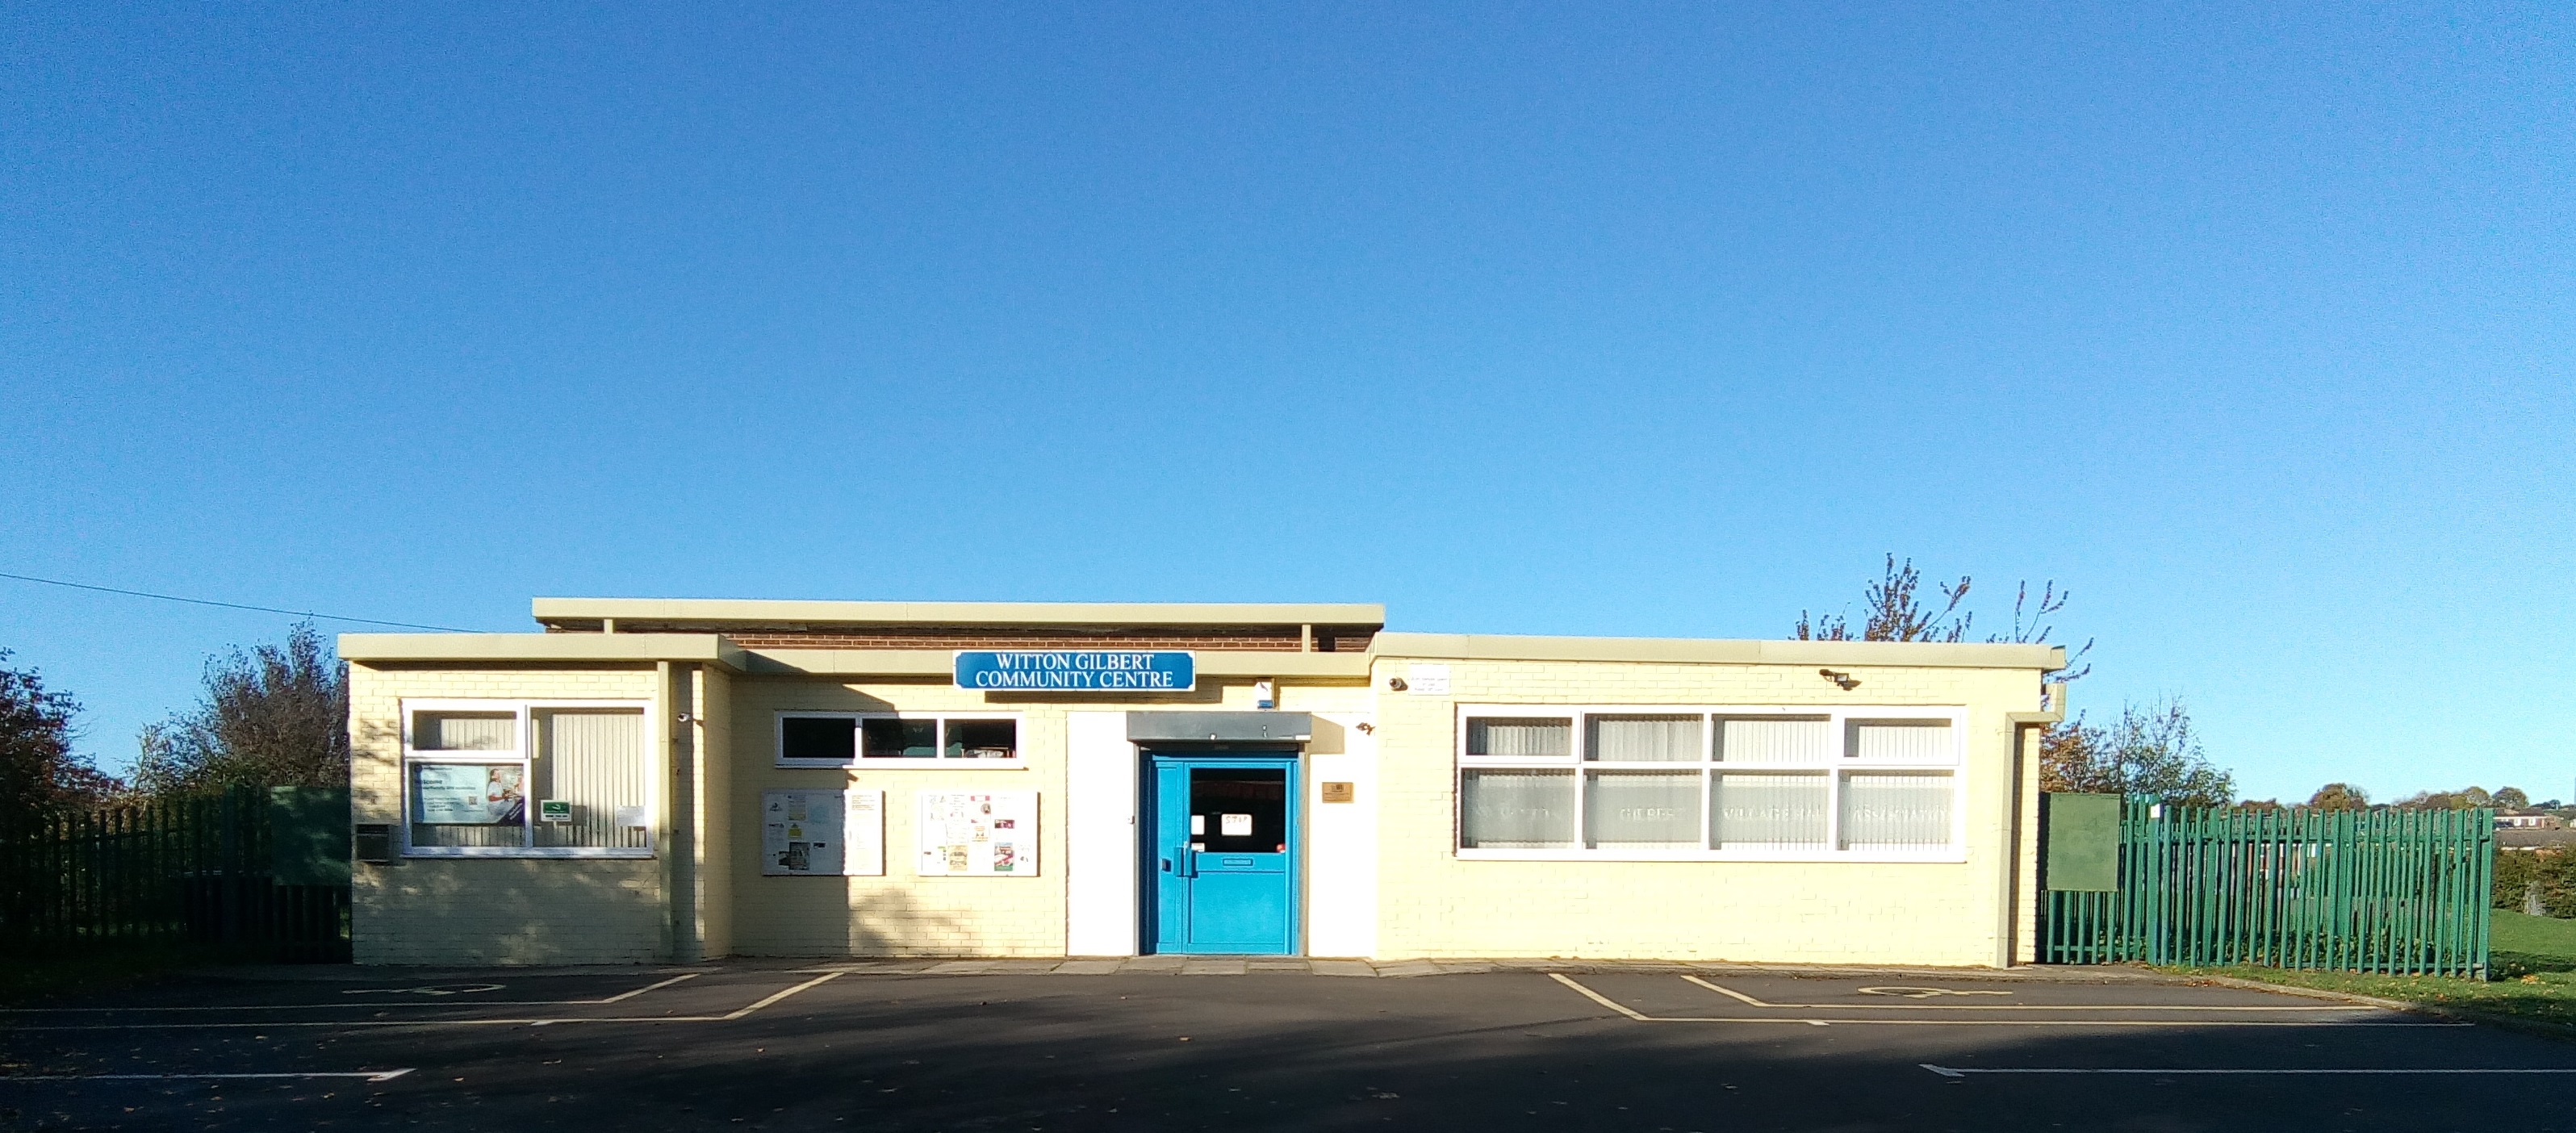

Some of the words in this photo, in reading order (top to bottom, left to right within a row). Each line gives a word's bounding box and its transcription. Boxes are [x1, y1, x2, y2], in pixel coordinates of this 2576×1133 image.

[996, 654, 1070, 670] WITTON
[1075, 654, 1155, 670] GILBERT
[976, 671, 1096, 688] COMMUNITY
[1100, 671, 1174, 688] CENTRE
